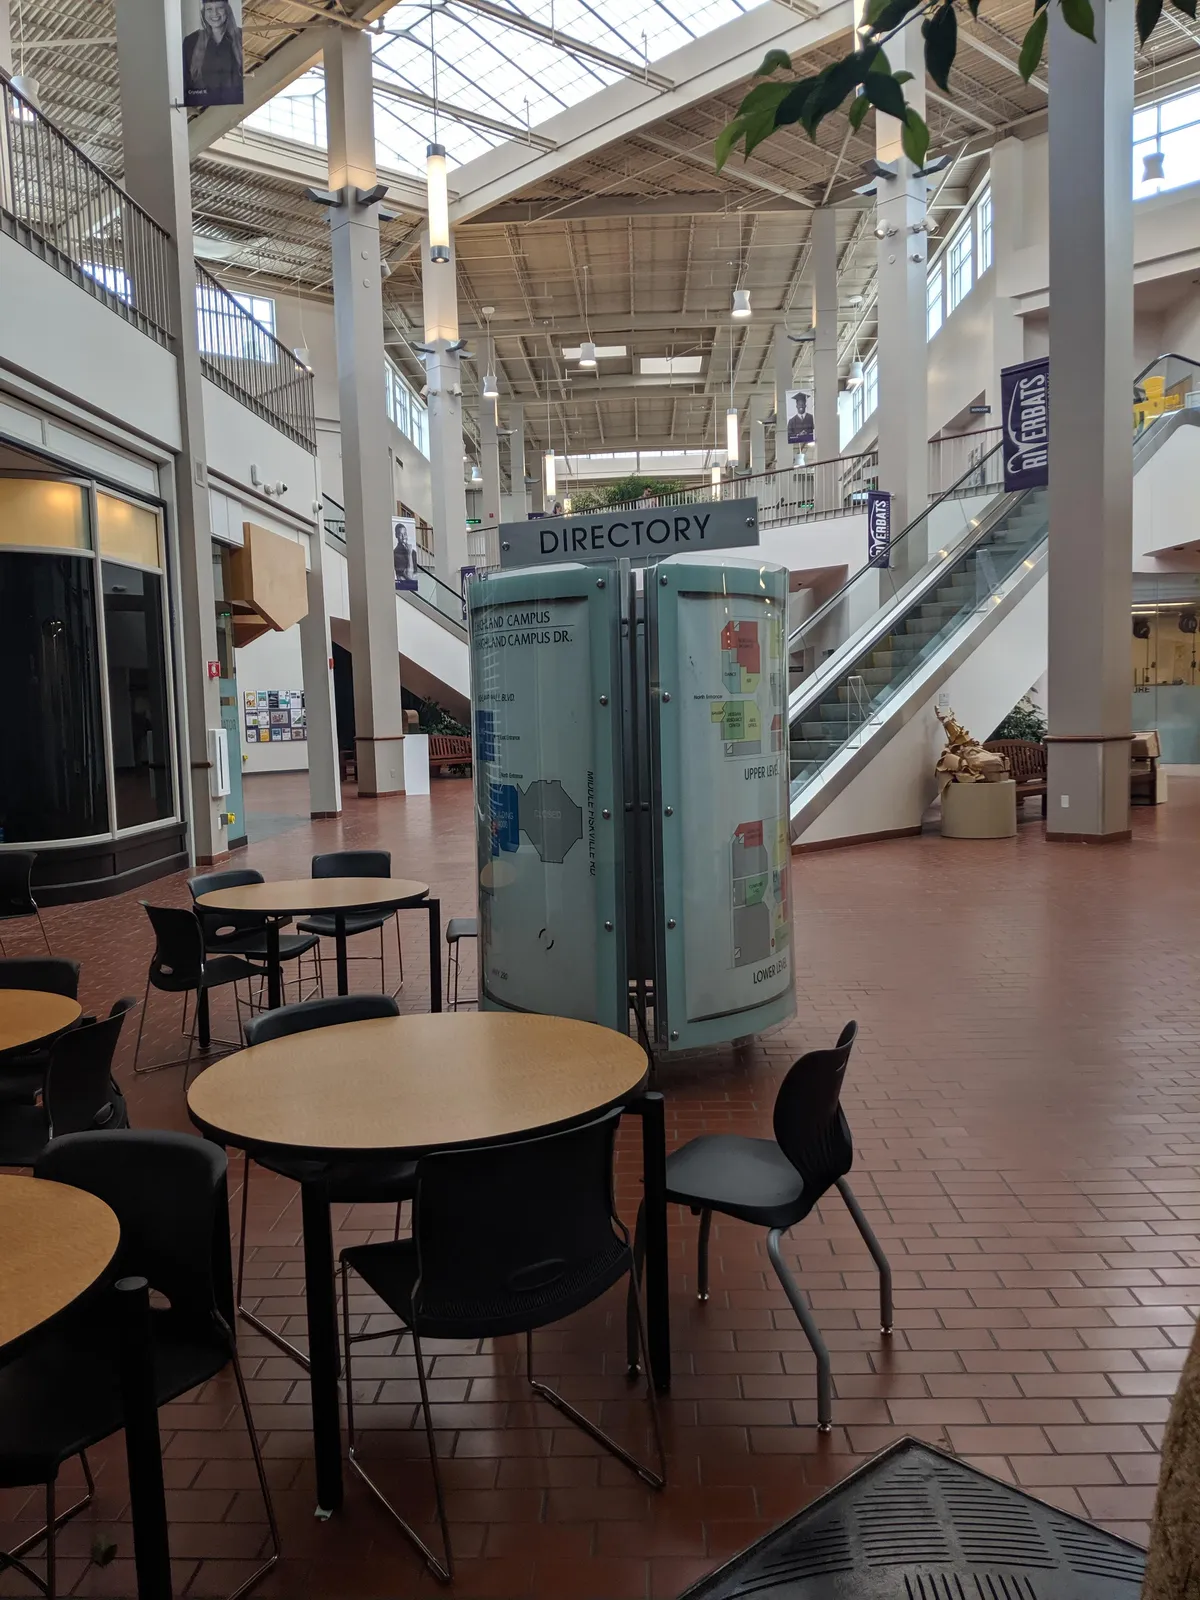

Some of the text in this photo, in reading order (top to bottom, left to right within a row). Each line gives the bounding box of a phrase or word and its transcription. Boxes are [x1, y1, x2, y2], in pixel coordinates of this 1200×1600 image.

[1013, 373, 1049, 472] RIVERBATS
[540, 514, 711, 554] DIRECTORY
[507, 611, 551, 627] CAMPUS
[507, 632, 551, 646] CAMPUS
[553, 630, 573, 643] DR.
[744, 766, 766, 780] UPPER
[753, 963, 775, 984] LOWER
